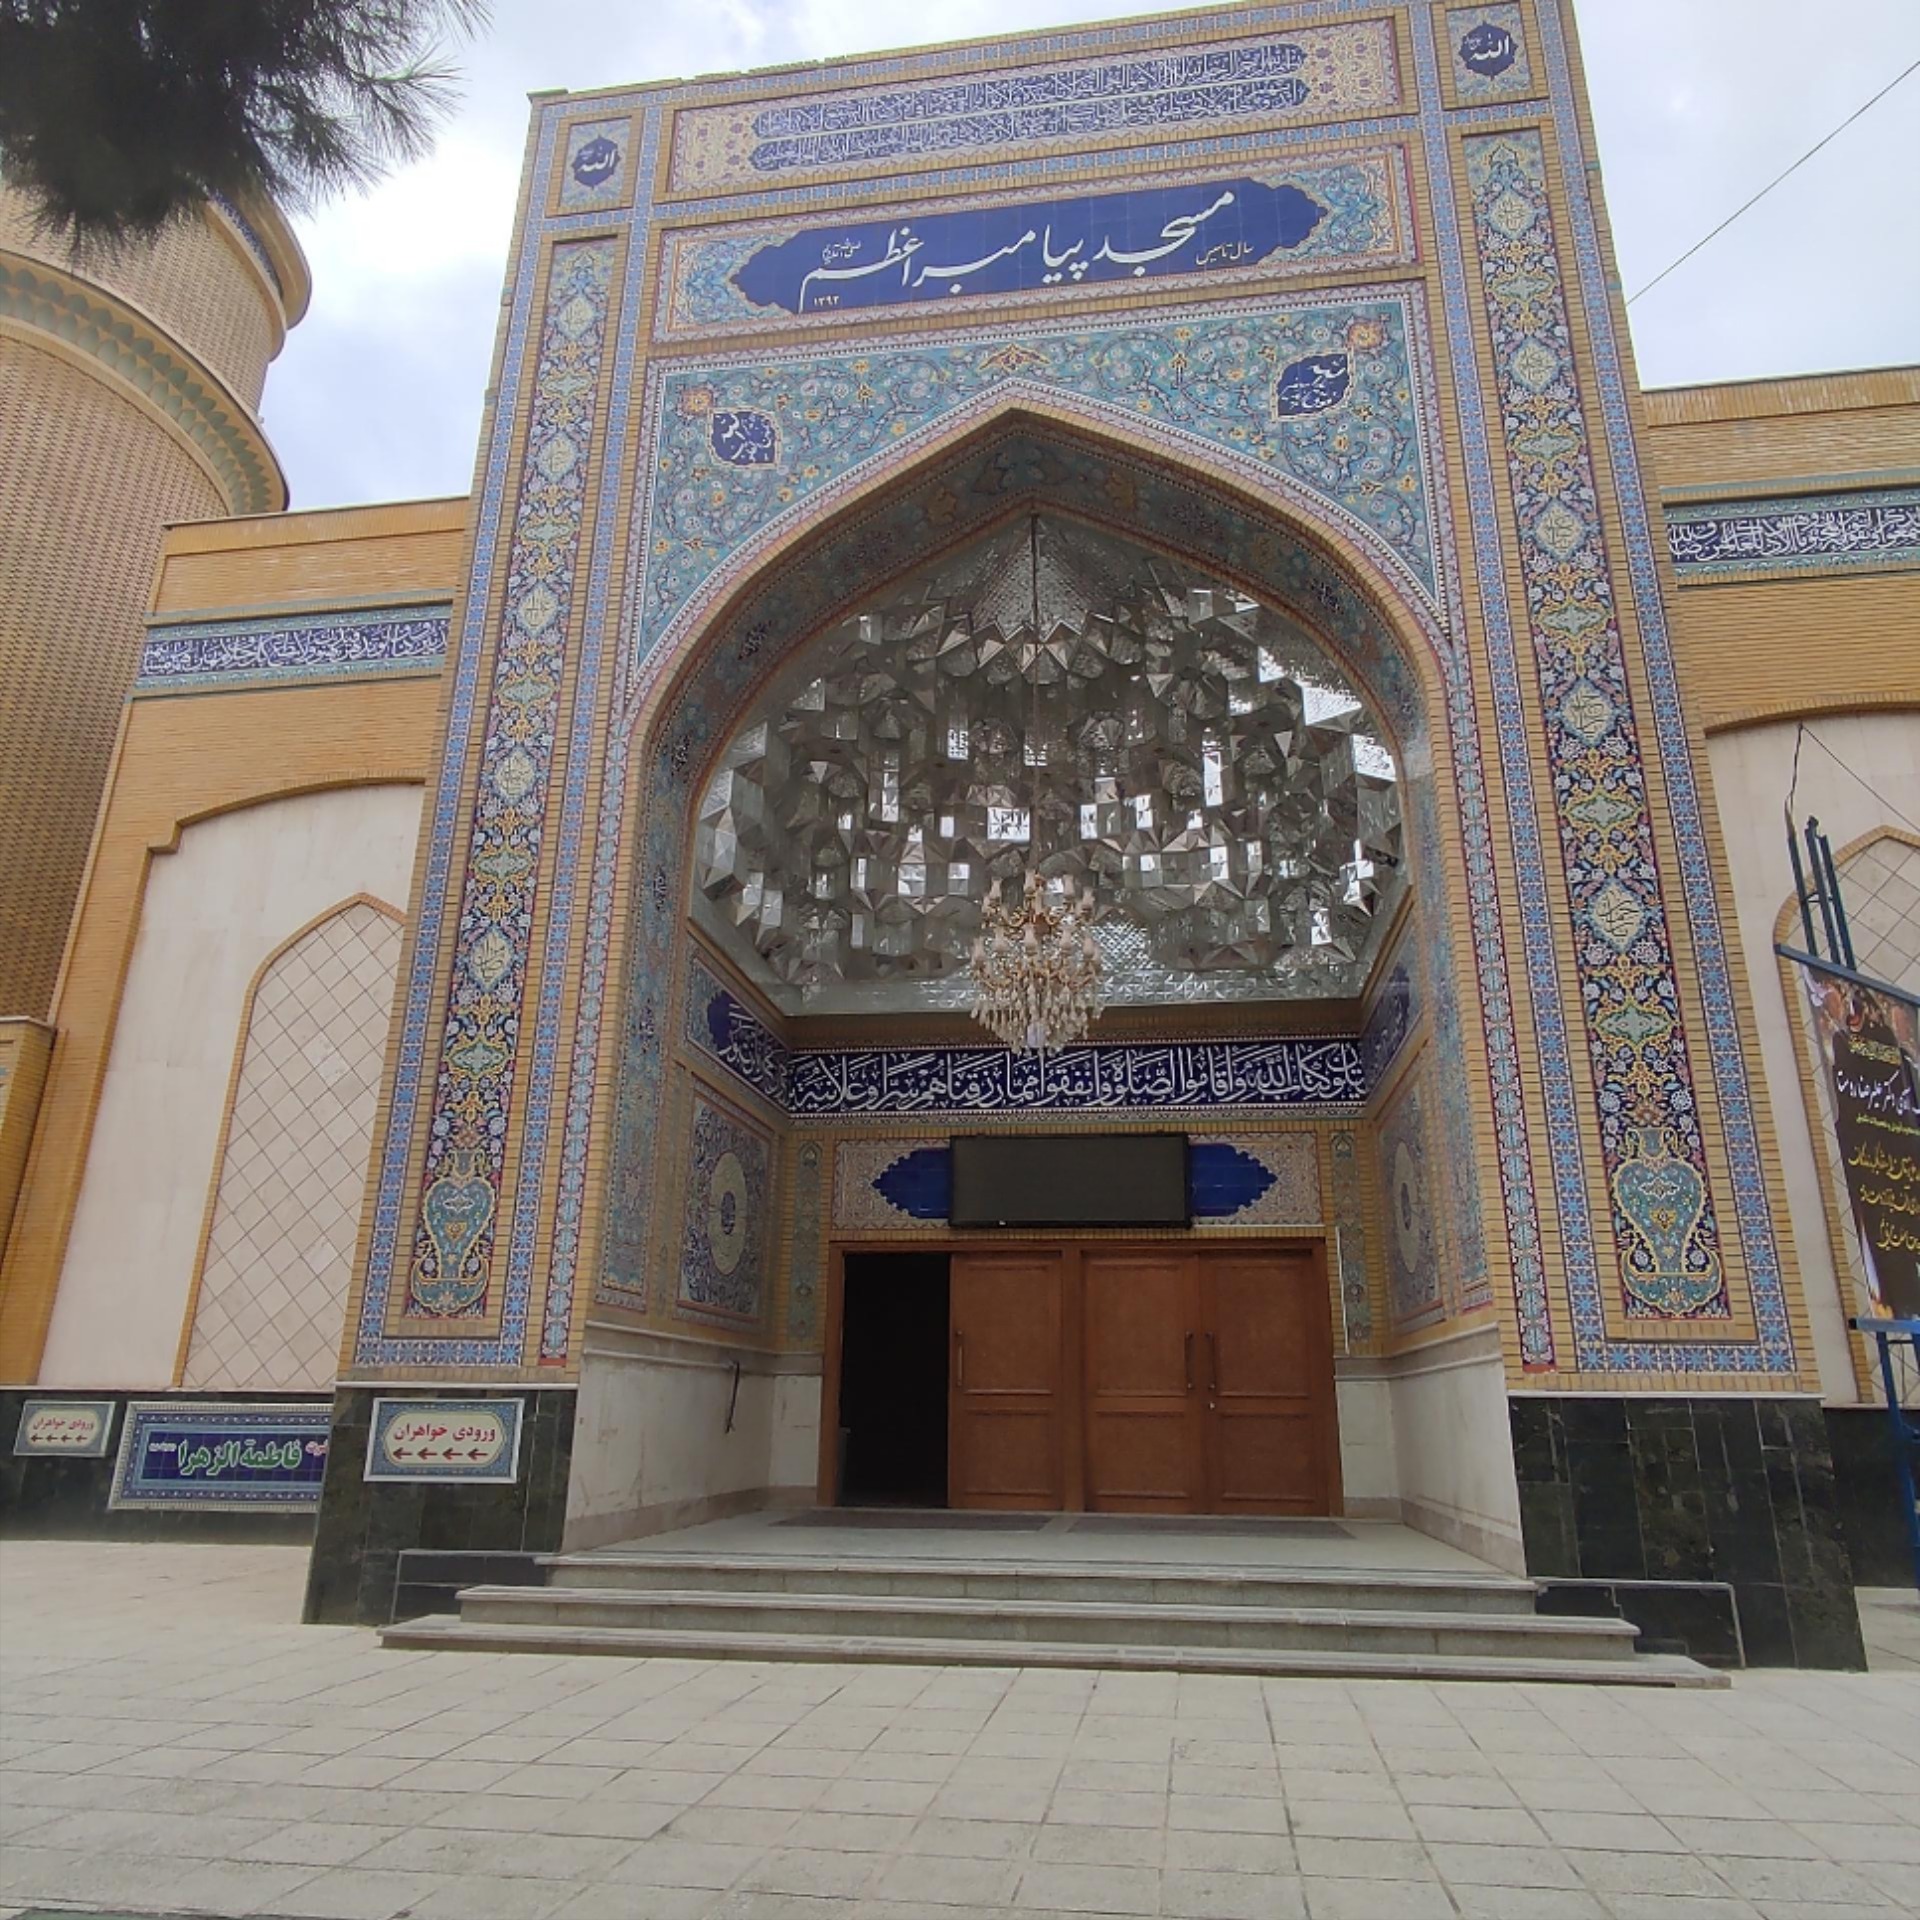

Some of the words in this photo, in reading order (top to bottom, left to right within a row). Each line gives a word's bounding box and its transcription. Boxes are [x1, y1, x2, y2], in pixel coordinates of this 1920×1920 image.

[1092, 190, 1235, 277] مسجد
[797, 226, 925, 313] اعظم
[393, 1423, 448, 1442] خواهران
[452, 1426, 497, 1442] ورودی
